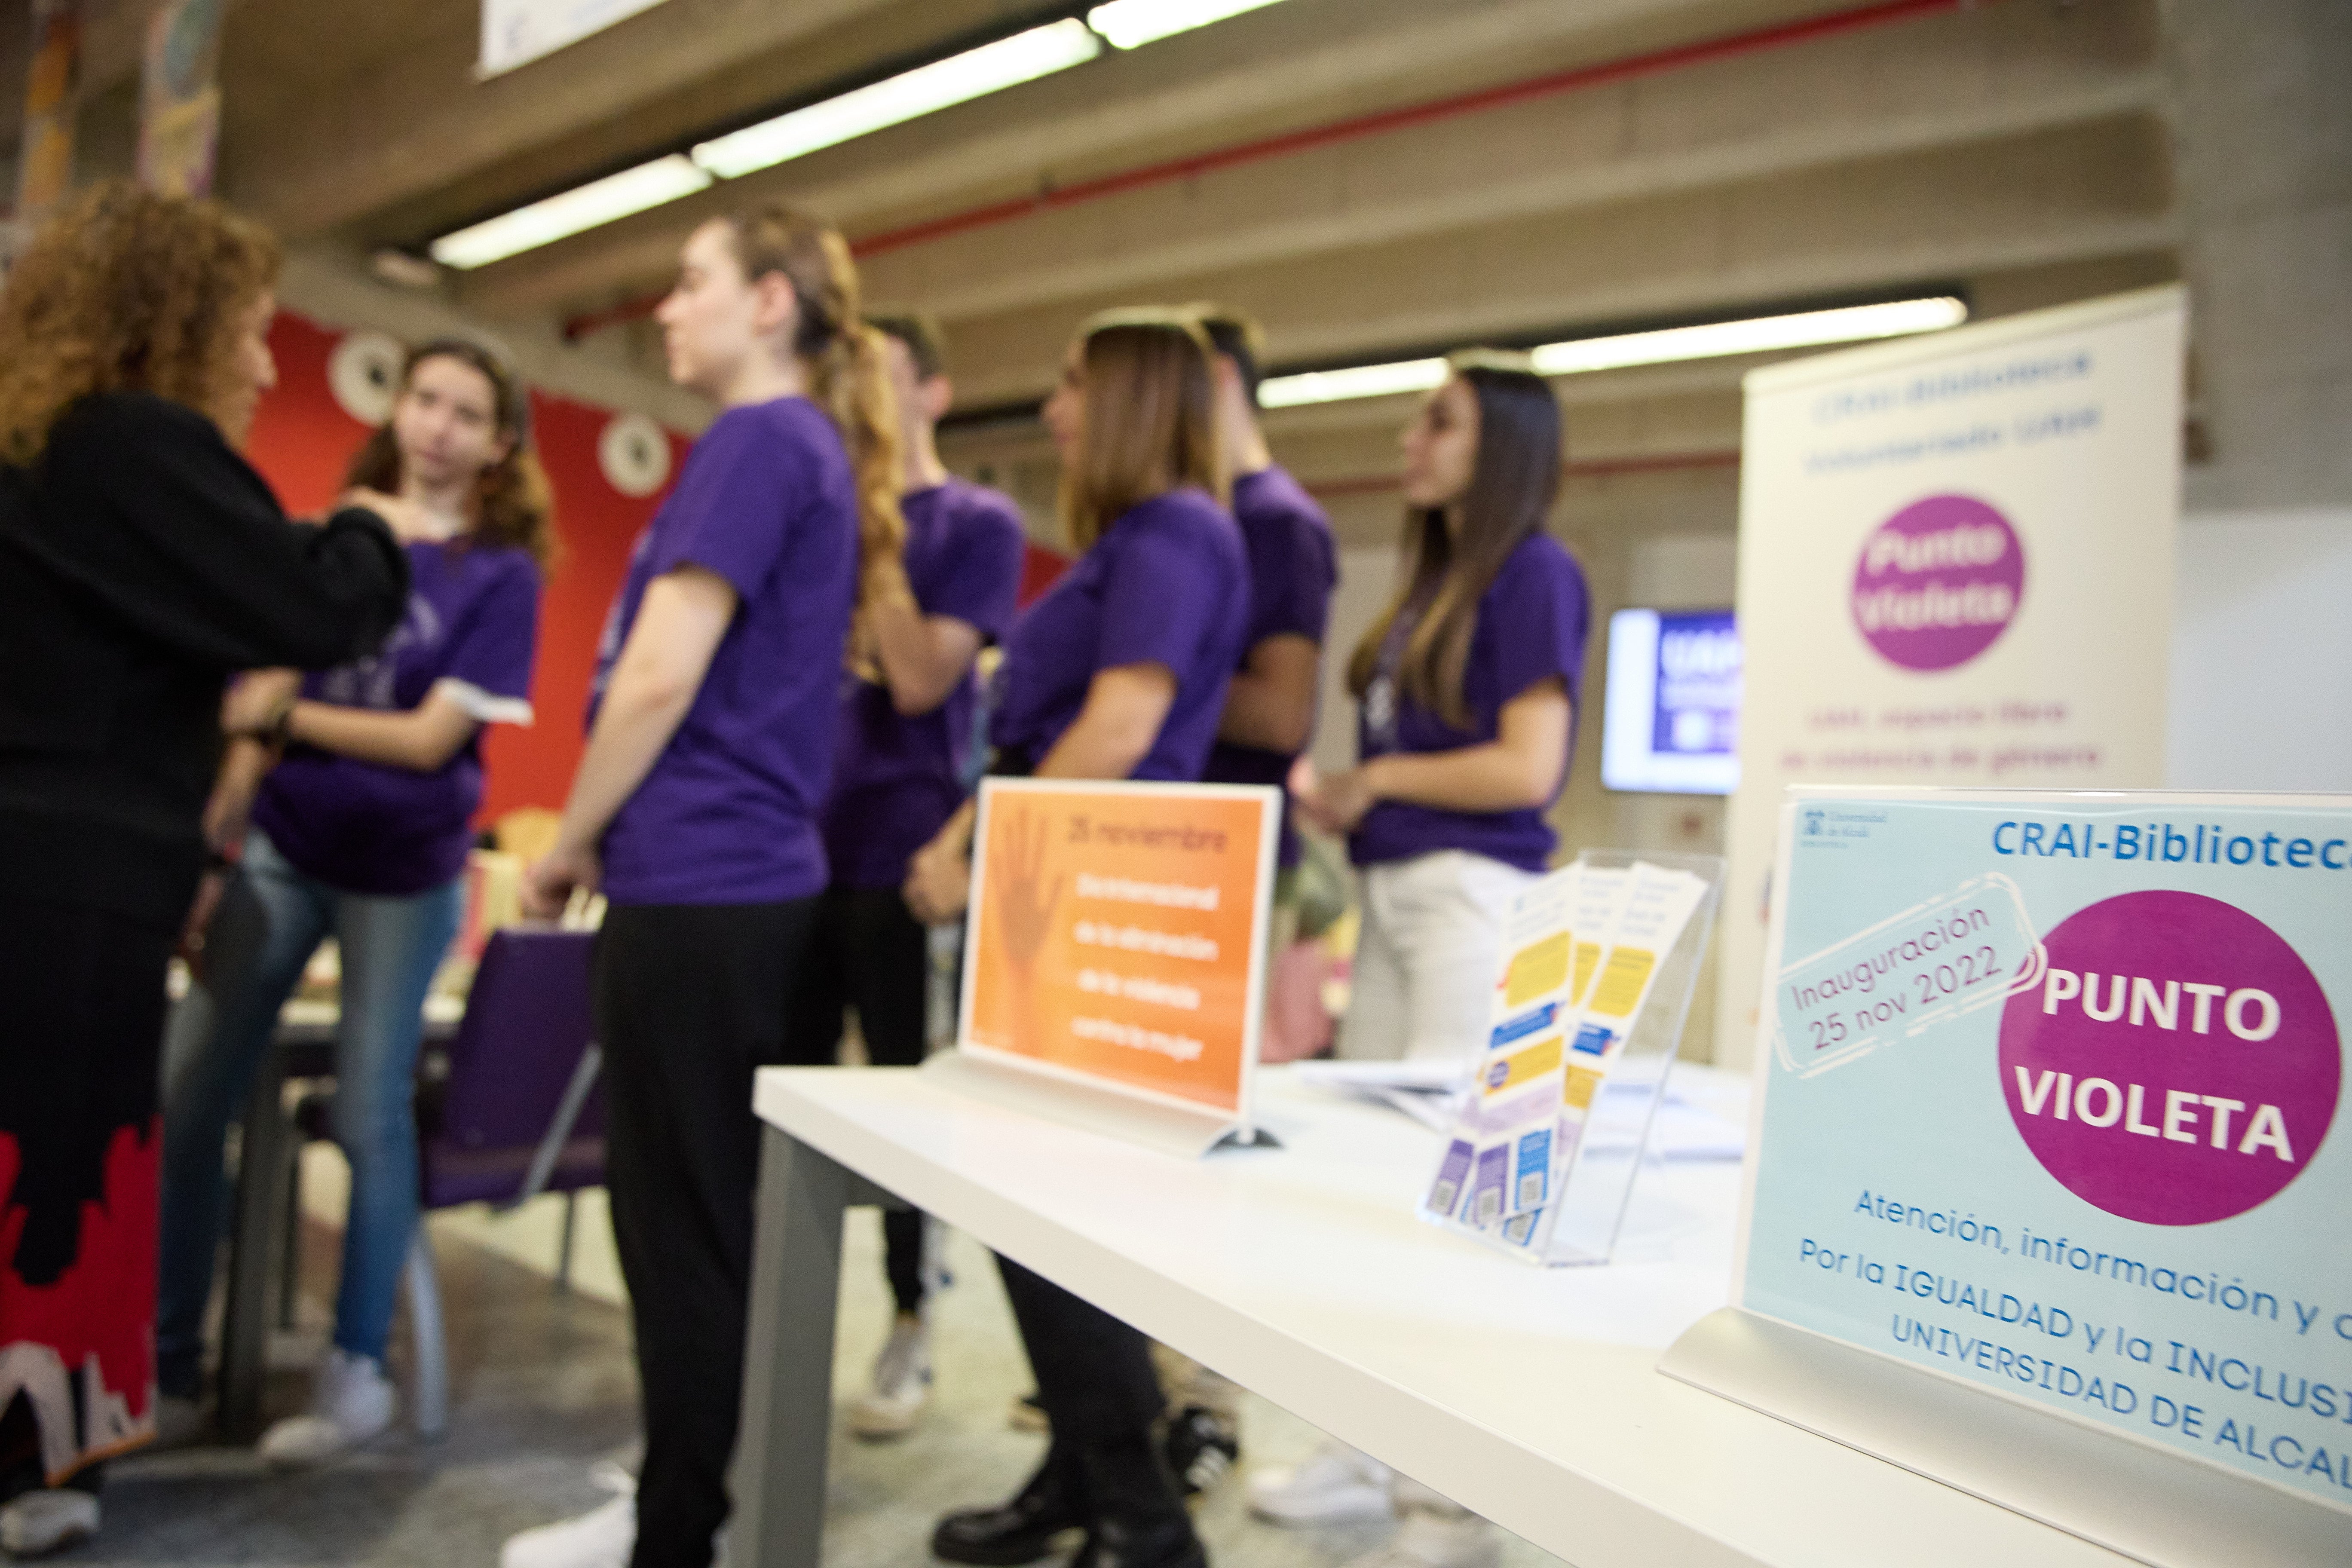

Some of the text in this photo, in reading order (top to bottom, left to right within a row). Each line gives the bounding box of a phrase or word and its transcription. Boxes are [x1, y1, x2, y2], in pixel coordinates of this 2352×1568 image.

[1866, 522, 2009, 579] Punto
[1992, 820, 2352, 870] CRAI-Bibliotec
[1792, 905, 1991, 1011] Inauguración
[1808, 944, 2003, 1051] 25 nov 2022
[2042, 968, 2282, 1042] PUNTO
[2014, 1065, 2296, 1163] VIOLETA
[1800, 1237, 1849, 1274] Por
[1857, 1253, 1884, 1286] la
[1892, 1264, 2074, 1340] IGUALDAD
[2085, 1322, 2107, 1353] y
[2115, 1326, 2153, 1365] la
[1853, 1189, 2010, 1255] Atención,
[2020, 1227, 2279, 1321] información
[2293, 1299, 2320, 1336] y
[1891, 1314, 2139, 1415] UNIVERSIDAD
[2150, 1394, 2205, 1440] DE
